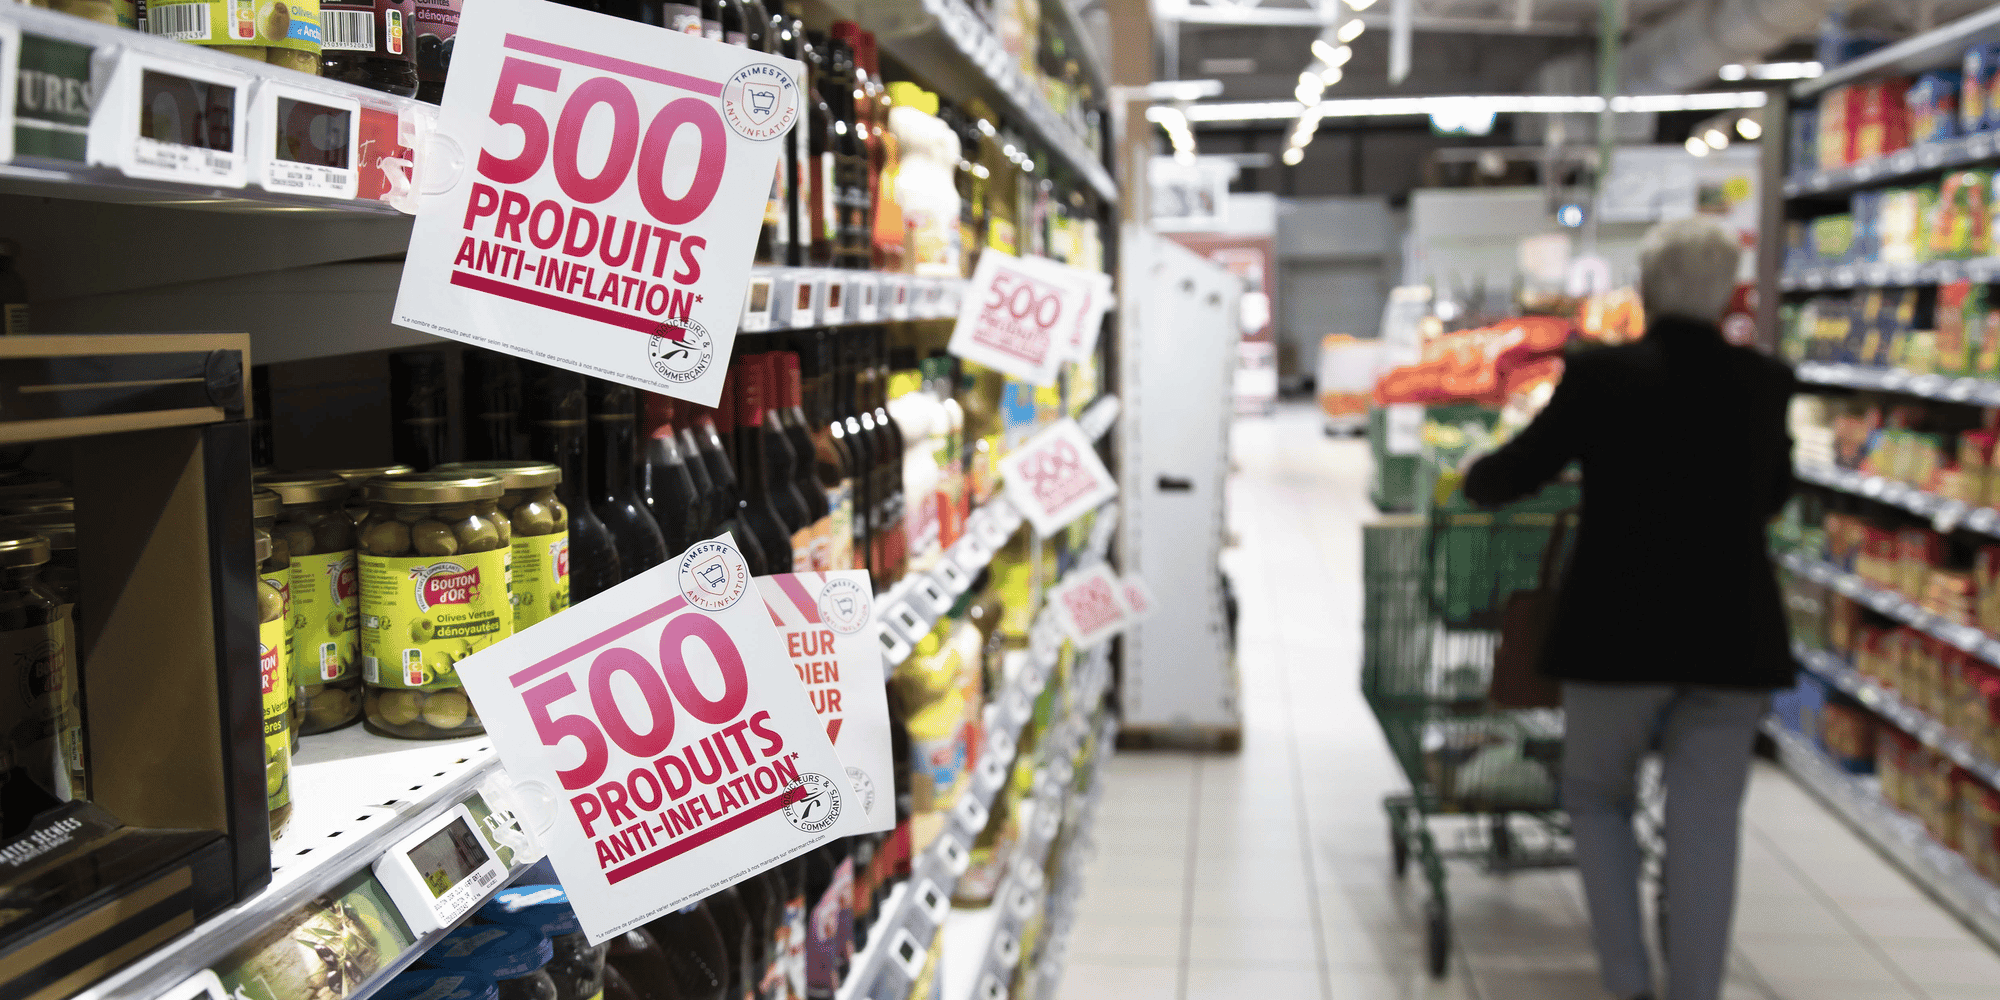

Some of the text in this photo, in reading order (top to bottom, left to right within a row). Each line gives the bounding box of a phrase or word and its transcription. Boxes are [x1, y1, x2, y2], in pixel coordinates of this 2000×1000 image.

[734, 66, 792, 90] TRIMESTRE
[726, 100, 794, 137] ANTI-INFLATION
[476, 56, 727, 226] 500
[463, 182, 706, 284] PRODUITS
[984, 269, 1062, 328] 500
[650, 319, 706, 348] PRODUCTEURS
[411, 318, 430, 328] nombre
[438, 325, 459, 335] produits
[460, 331, 471, 339] peut
[472, 334, 487, 342] varier
[487, 338, 501, 346] selon
[510, 344, 534, 355] magasins,
[535, 350, 546, 358] liste
[547, 352, 556, 360] des
[556, 356, 578, 367] produits
[593, 366, 616, 376] marques
[626, 373, 670, 390] intermarché.com
[654, 354, 710, 381] COMMERÇANTS
[682, 544, 728, 574] TRIMESTRE
[430, 574, 476, 592] BOUTON
[440, 588, 466, 603] d'OR
[687, 564, 744, 608] ANTI-INFLATION
[823, 581, 860, 597] TRIMESTRE
[436, 609, 495, 622] Olives Vertes
[437, 622, 499, 637] dénoyautées
[787, 630, 836, 658] EUR
[260, 654, 276, 672] TON
[520, 612, 748, 792] 500
[810, 688, 842, 714] UR
[264, 720, 282, 734] ères
[570, 710, 784, 839] PRODUITS
[784, 774, 820, 816] PRODUCTEURS
[800, 790, 840, 830] COMMERÇANTS
[604, 925, 621, 935] nombre
[628, 914, 646, 926] produits
[646, 910, 656, 918] peut
[656, 904, 669, 912] varier
[670, 899, 681, 907] selon
[688, 887, 710, 898] magasins,
[728, 870, 747, 881] produits
[760, 855, 779, 866] marques
[787, 834, 825, 854] intermarché.com
